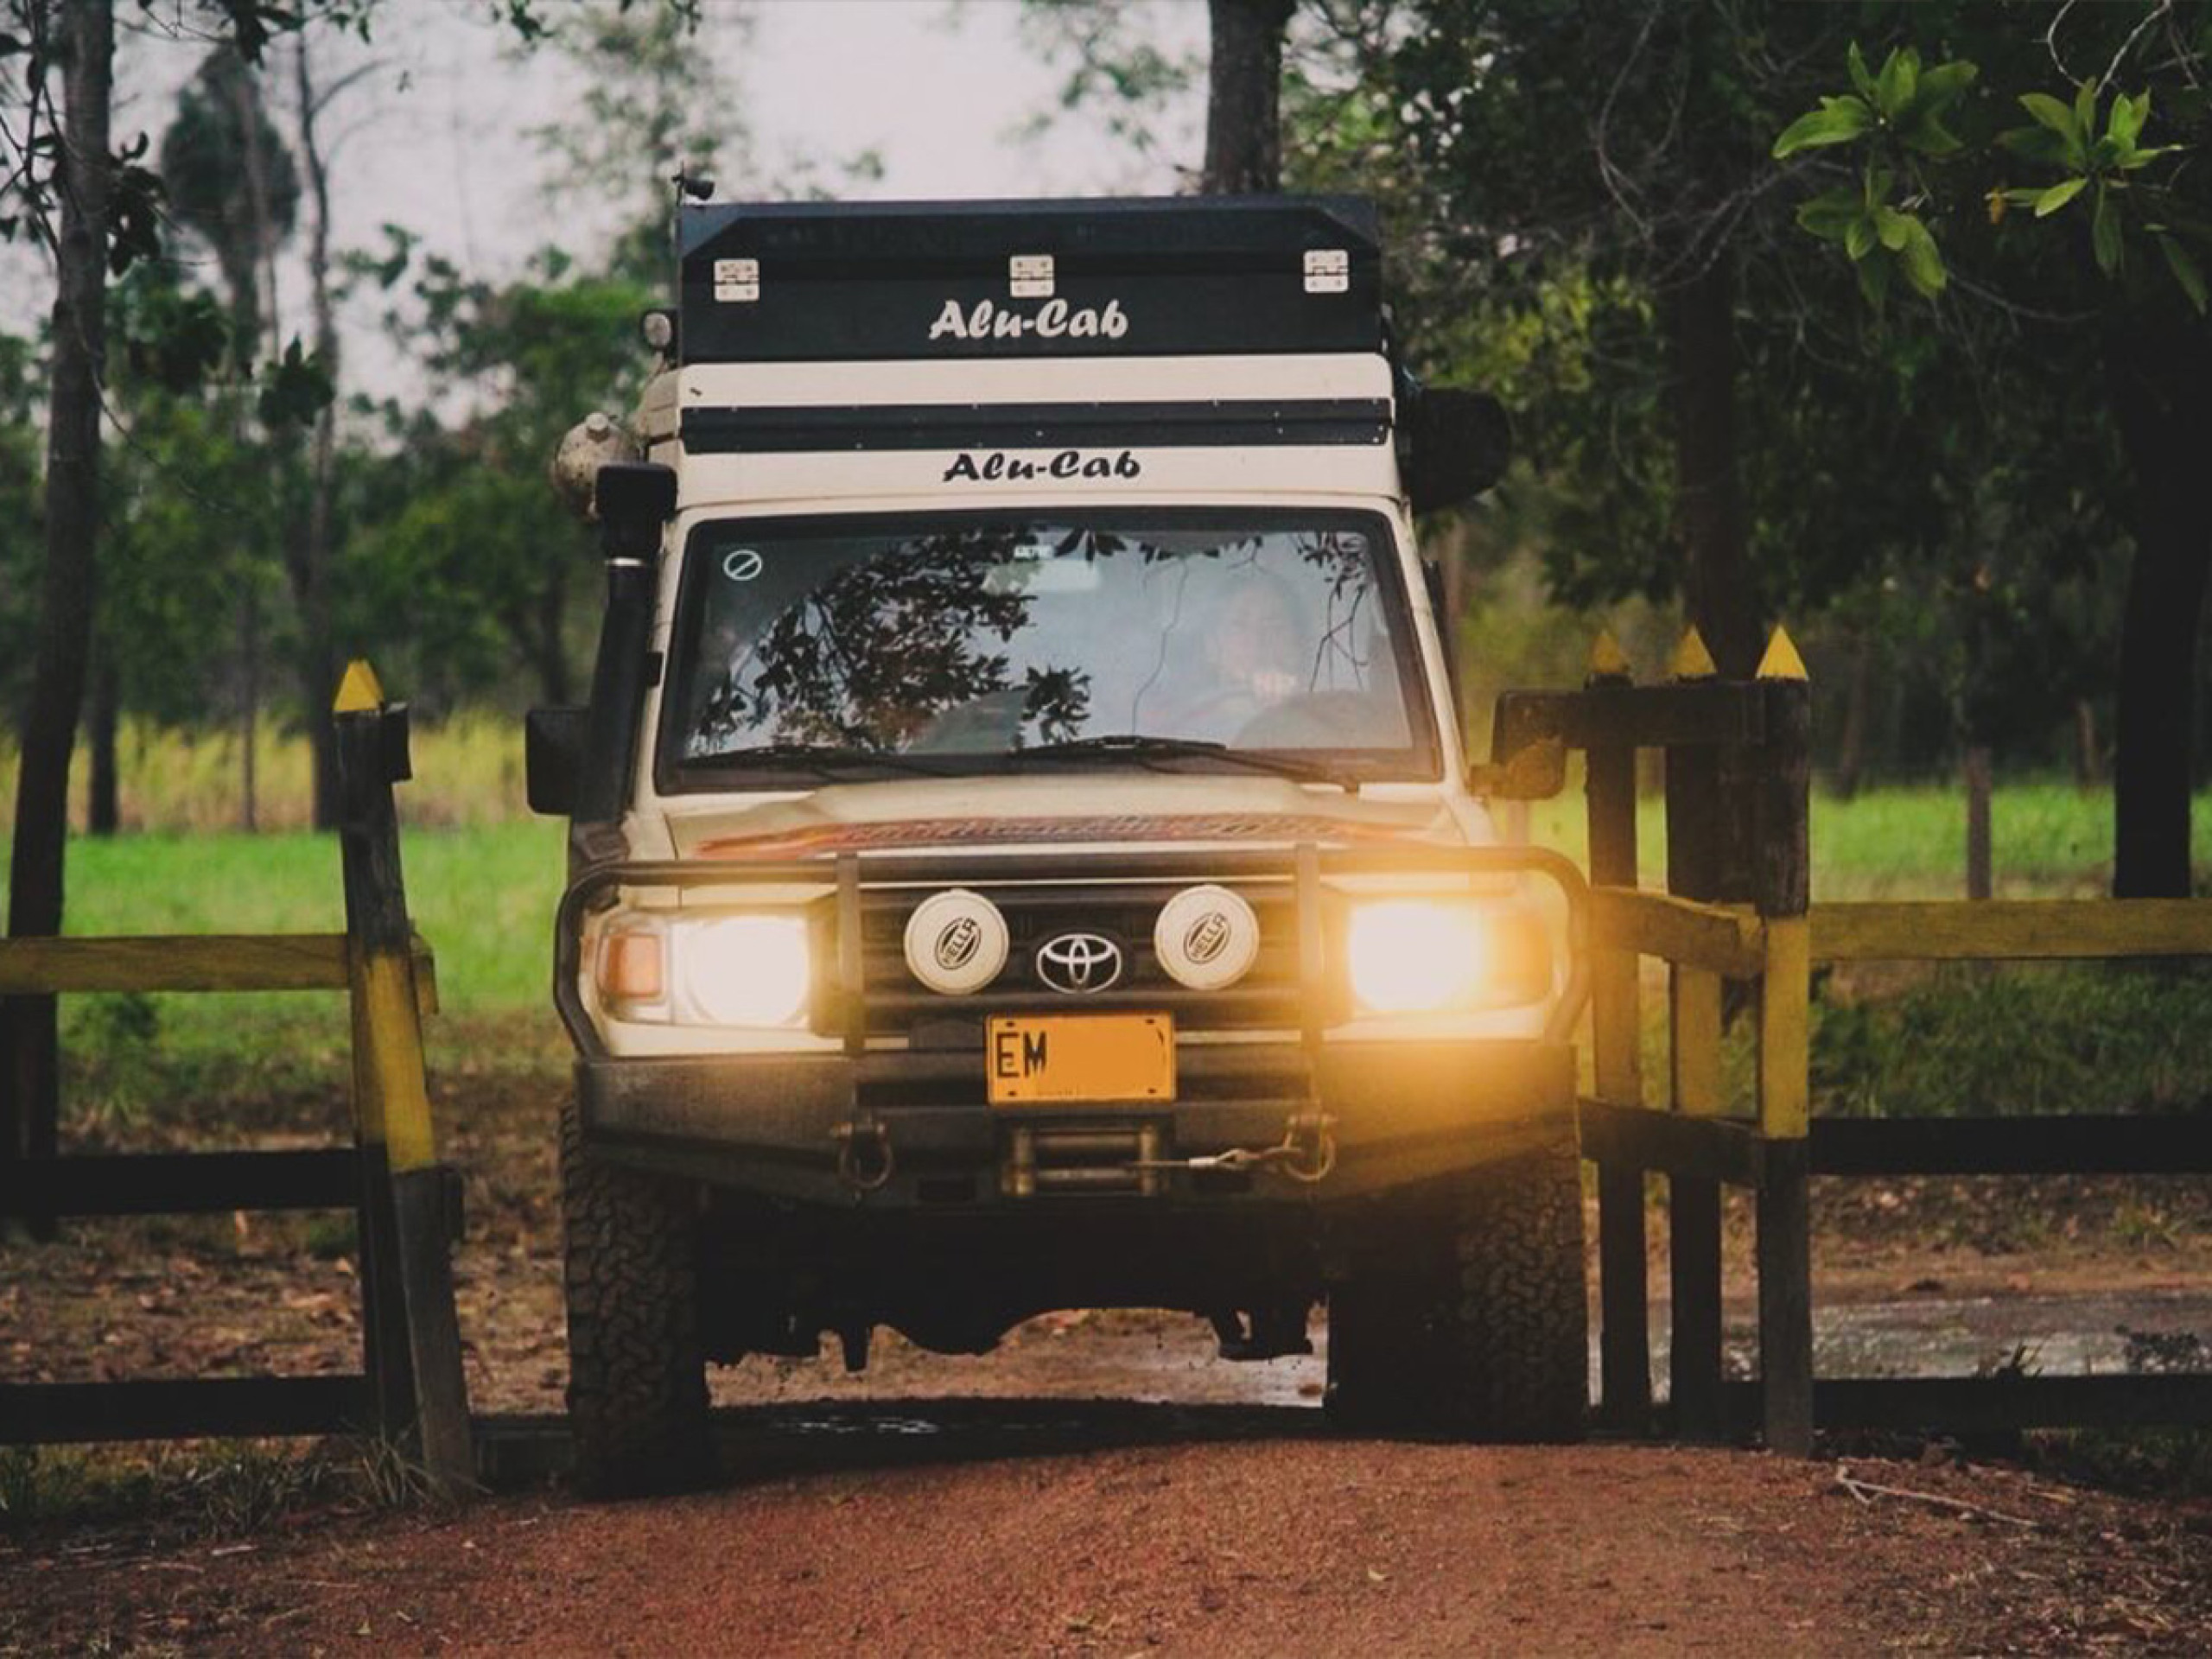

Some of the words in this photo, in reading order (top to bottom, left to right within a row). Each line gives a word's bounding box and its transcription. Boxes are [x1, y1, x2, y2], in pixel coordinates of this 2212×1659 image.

[928, 298, 1128, 340] Alu-Cab
[943, 450, 1141, 482] Alu-Cab
[995, 1030, 1048, 1078] EM
